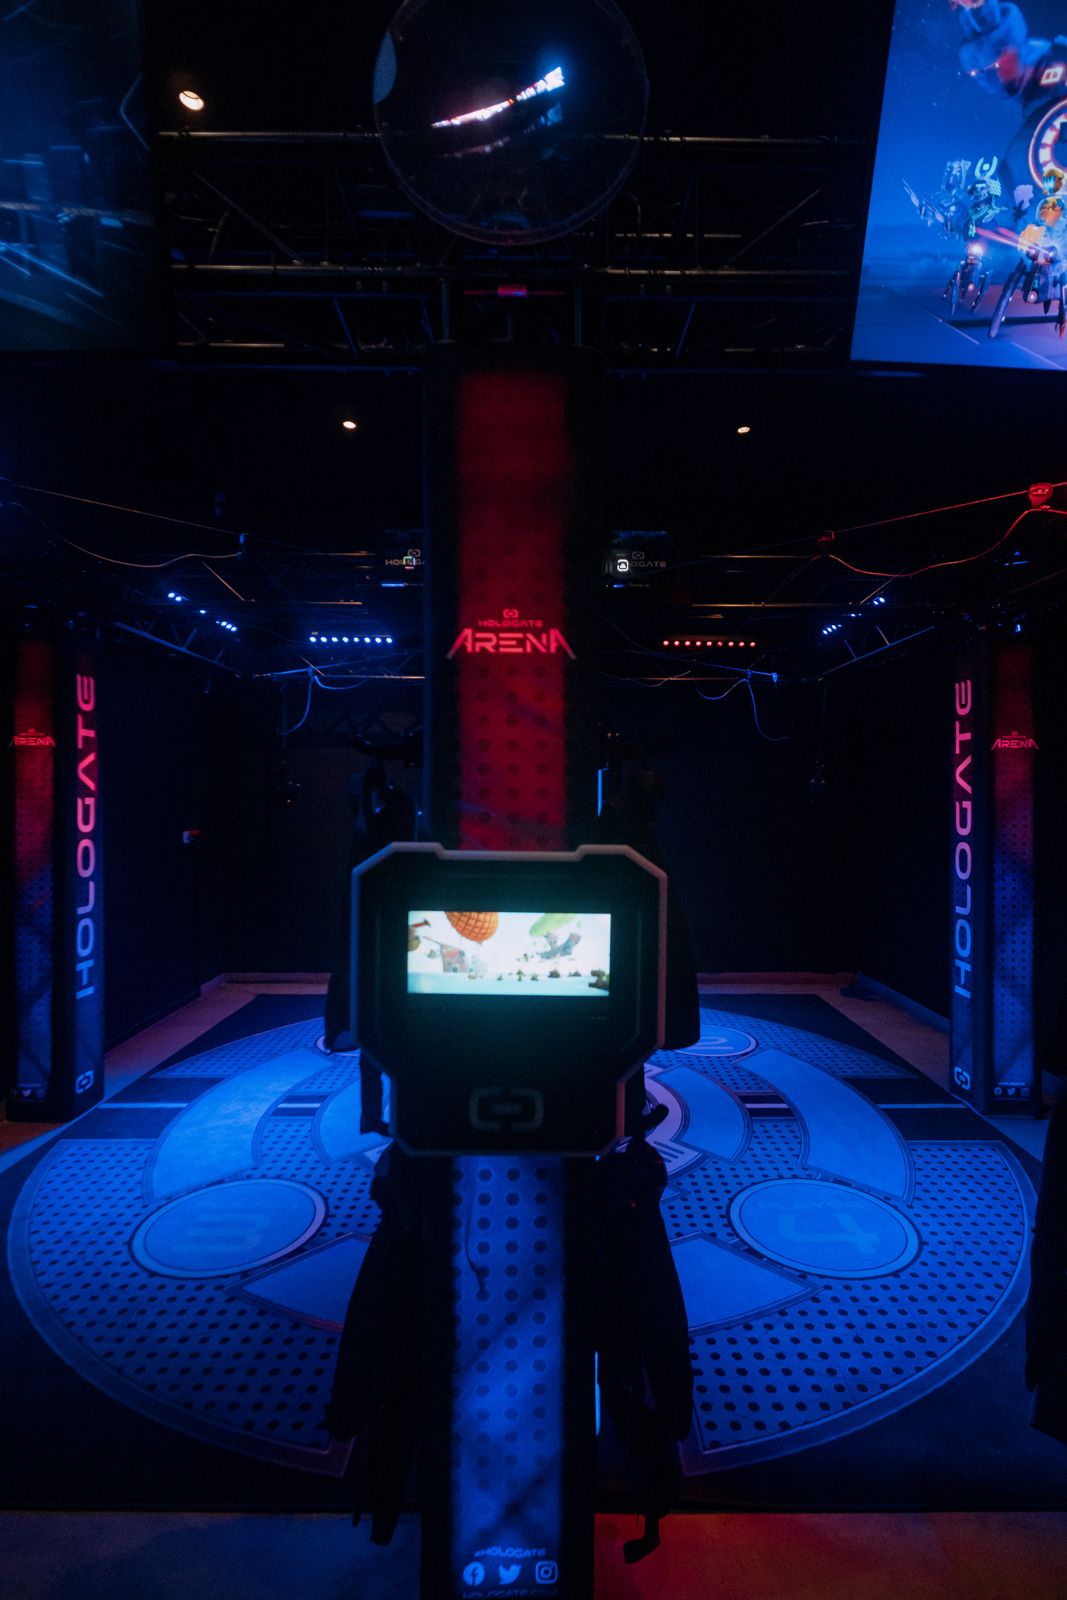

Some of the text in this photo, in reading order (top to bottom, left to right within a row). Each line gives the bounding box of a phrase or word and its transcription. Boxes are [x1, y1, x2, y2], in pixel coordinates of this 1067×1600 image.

[477, 619, 544, 629] HOLOGATE
[446, 628, 577, 659] ARENA
[990, 738, 1040, 751] ARENA
[75, 673, 97, 1000] HOLOGATE
[954, 679, 973, 1000] HOLOGATE
